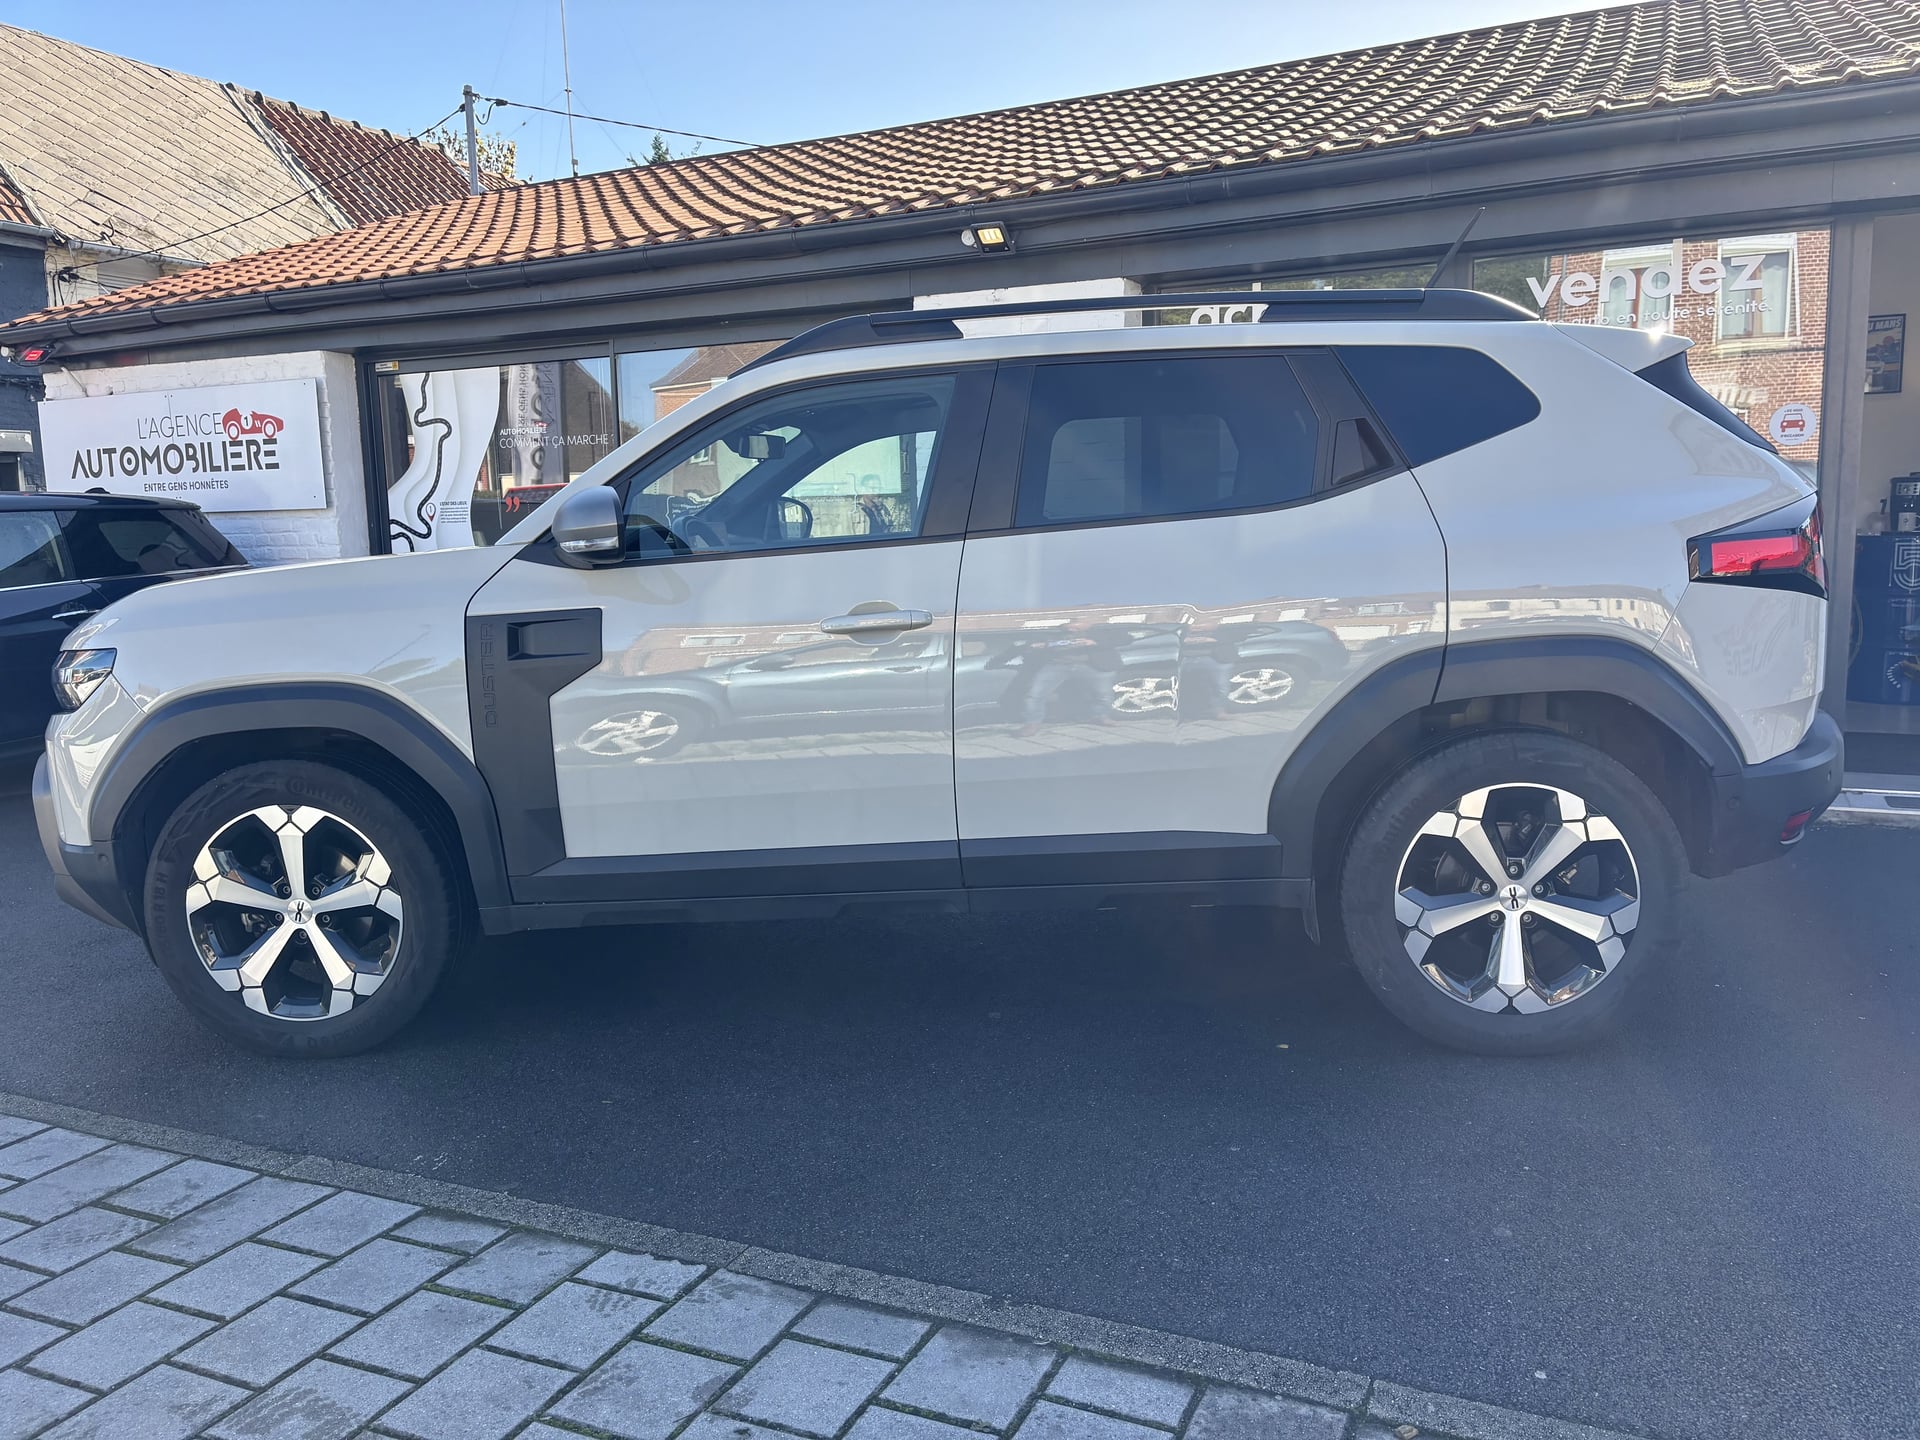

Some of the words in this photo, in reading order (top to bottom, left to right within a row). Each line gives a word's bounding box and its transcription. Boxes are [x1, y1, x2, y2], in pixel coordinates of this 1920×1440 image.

[1526, 238, 1767, 308] vendez
[1617, 312, 1637, 324] en
[1643, 306, 1690, 322] toute
[137, 412, 224, 440] L'AGENCE
[499, 436, 549, 449] COMMENT
[551, 435, 565, 449] ÇA
[567, 433, 609, 446] MARCHE
[143, 482, 167, 492] ENTRE
[168, 480, 188, 491] GENS
[189, 477, 229, 490] HONNÊTES
[481, 623, 497, 729] DUSTER
